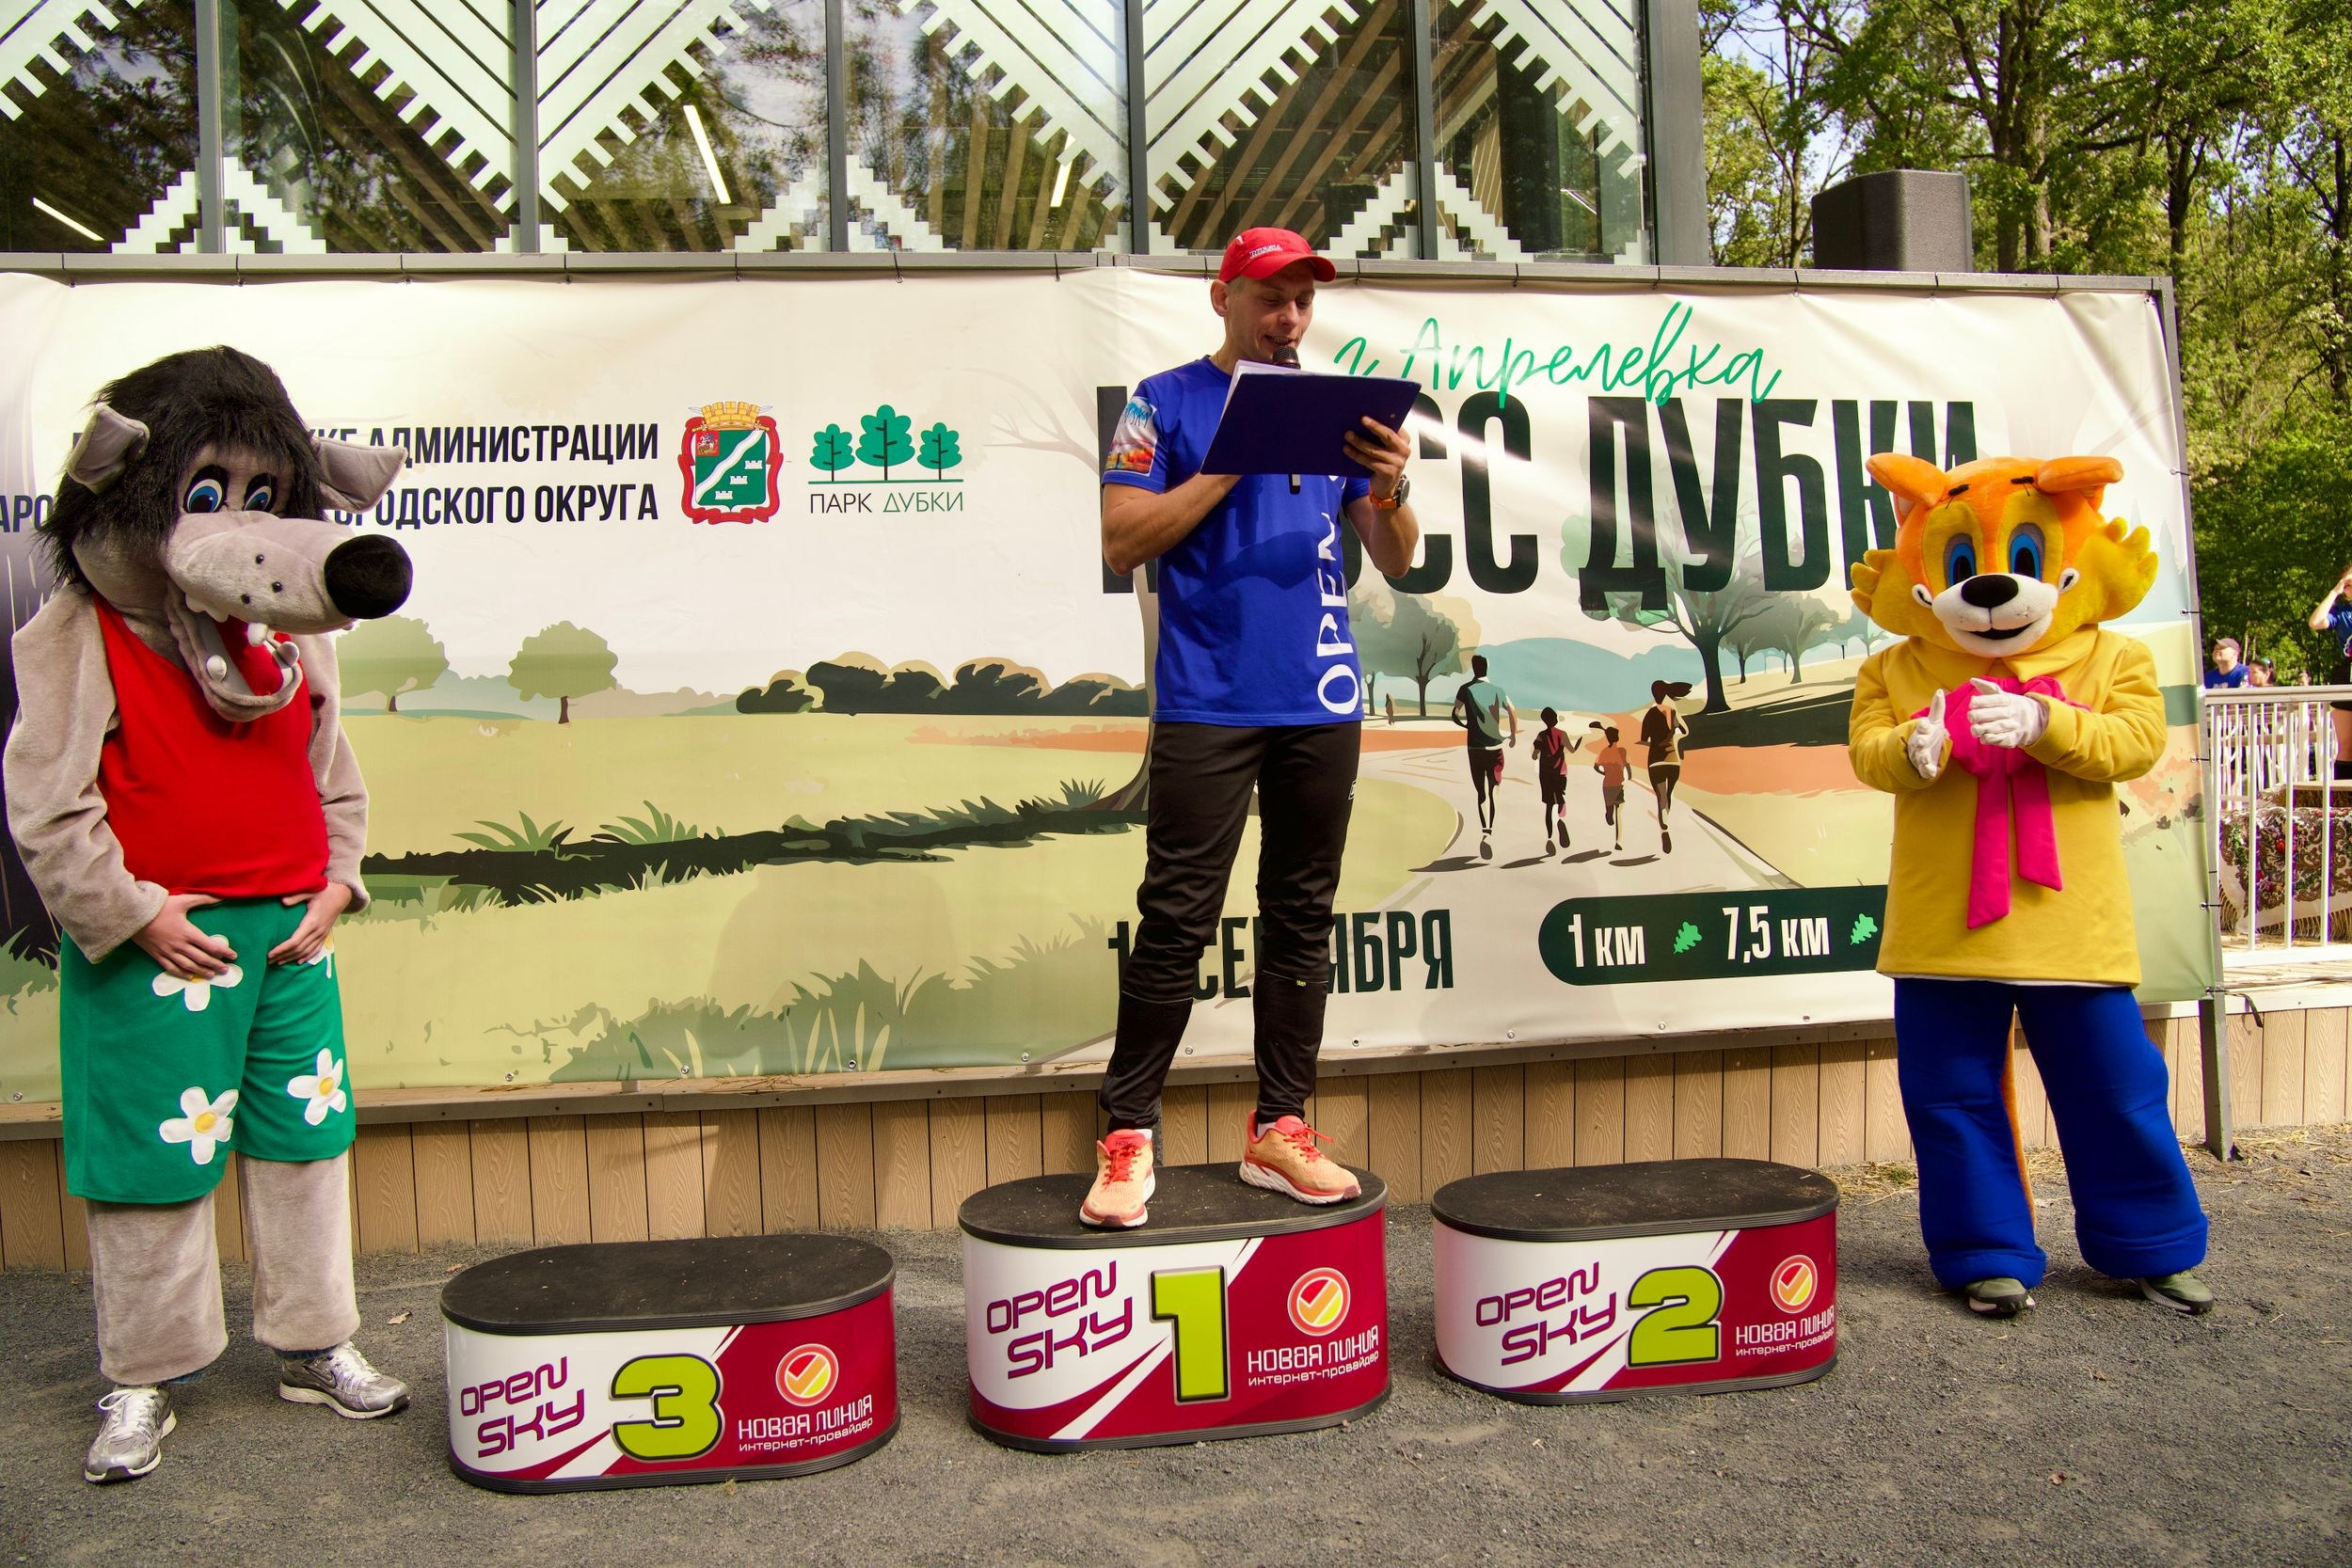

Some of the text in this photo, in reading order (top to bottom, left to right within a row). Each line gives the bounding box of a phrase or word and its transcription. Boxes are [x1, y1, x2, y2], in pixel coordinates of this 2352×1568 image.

[1399, 301, 1783, 409] Апрелевка
[534, 483, 659, 525] ОКРУГА
[809, 491, 963, 515] ПАРК ДУБКИ
[1316, 512, 1359, 716] OPEN
[1567, 913, 1584, 968] 1
[1722, 905, 1772, 963] 7,5
[1008, 1296, 1134, 1380] SKY
[1150, 1264, 1232, 1405] 1
[1501, 1291, 1617, 1367] SKY
[1626, 1264, 1724, 1368] 2
[1248, 1350, 1379, 1386] интернет-провайдер
[477, 1387, 585, 1459] SKY
[610, 1353, 724, 1463] 3
[739, 1417, 874, 1452] интернет-провайдер
